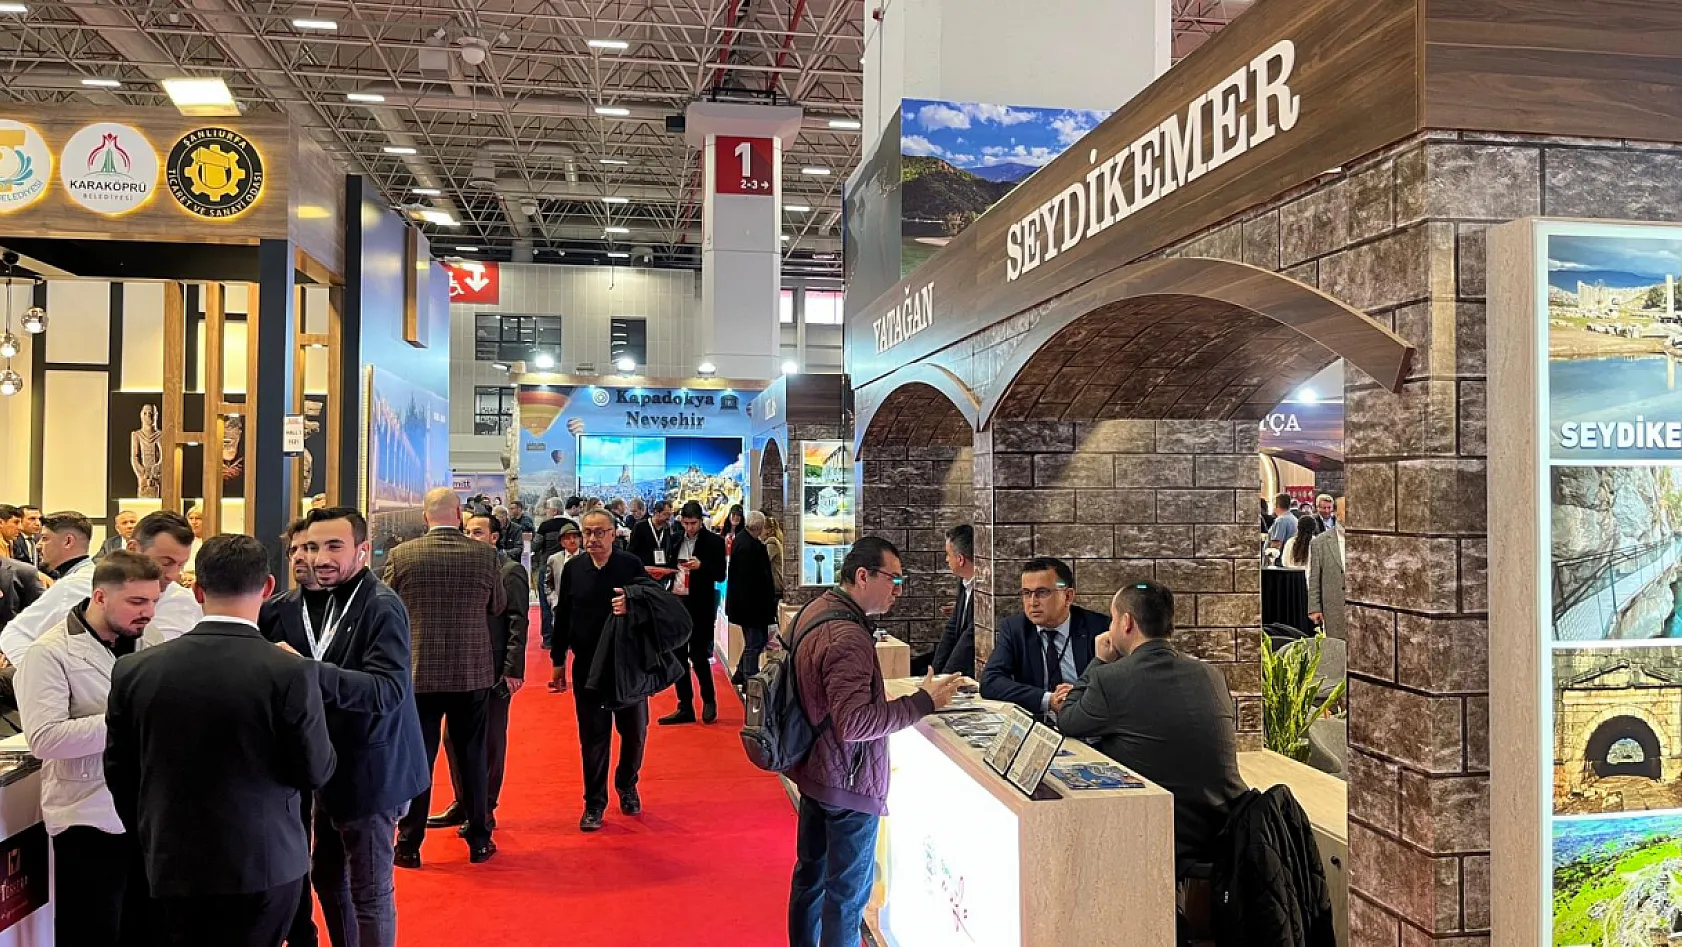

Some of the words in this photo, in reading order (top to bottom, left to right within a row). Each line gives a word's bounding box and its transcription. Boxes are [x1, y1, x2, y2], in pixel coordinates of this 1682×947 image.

[734, 142, 751, 177] 1
[1006, 39, 1300, 283] SEYDİKEMER
[70, 179, 147, 193] KARAKÖPRÜ
[740, 179, 758, 189] 2-3
[873, 281, 935, 356] YATAĞAN
[615, 388, 714, 407] Kapadokya
[626, 411, 705, 429] Nevşehir
